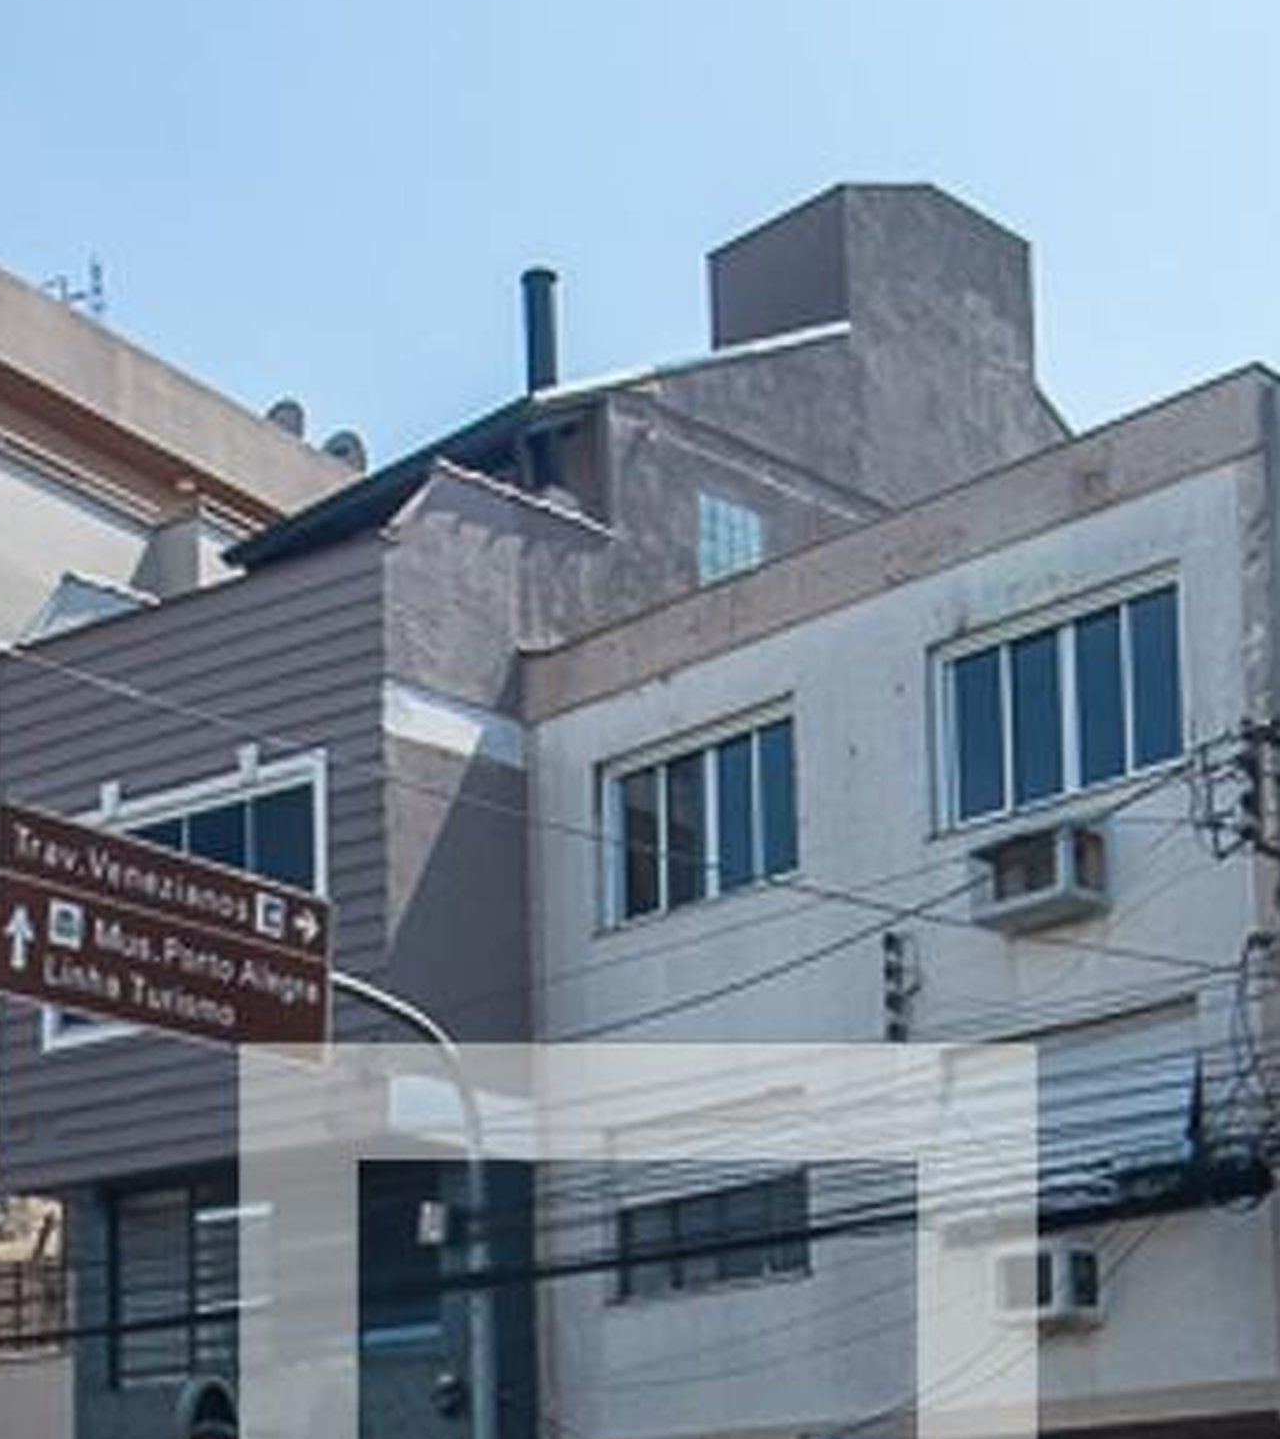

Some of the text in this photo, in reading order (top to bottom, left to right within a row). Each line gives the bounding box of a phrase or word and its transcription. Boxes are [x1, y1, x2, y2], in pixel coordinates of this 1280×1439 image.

[42, 954, 236, 1026] Linha Turismo
[238, 961, 319, 1004] Alegre
